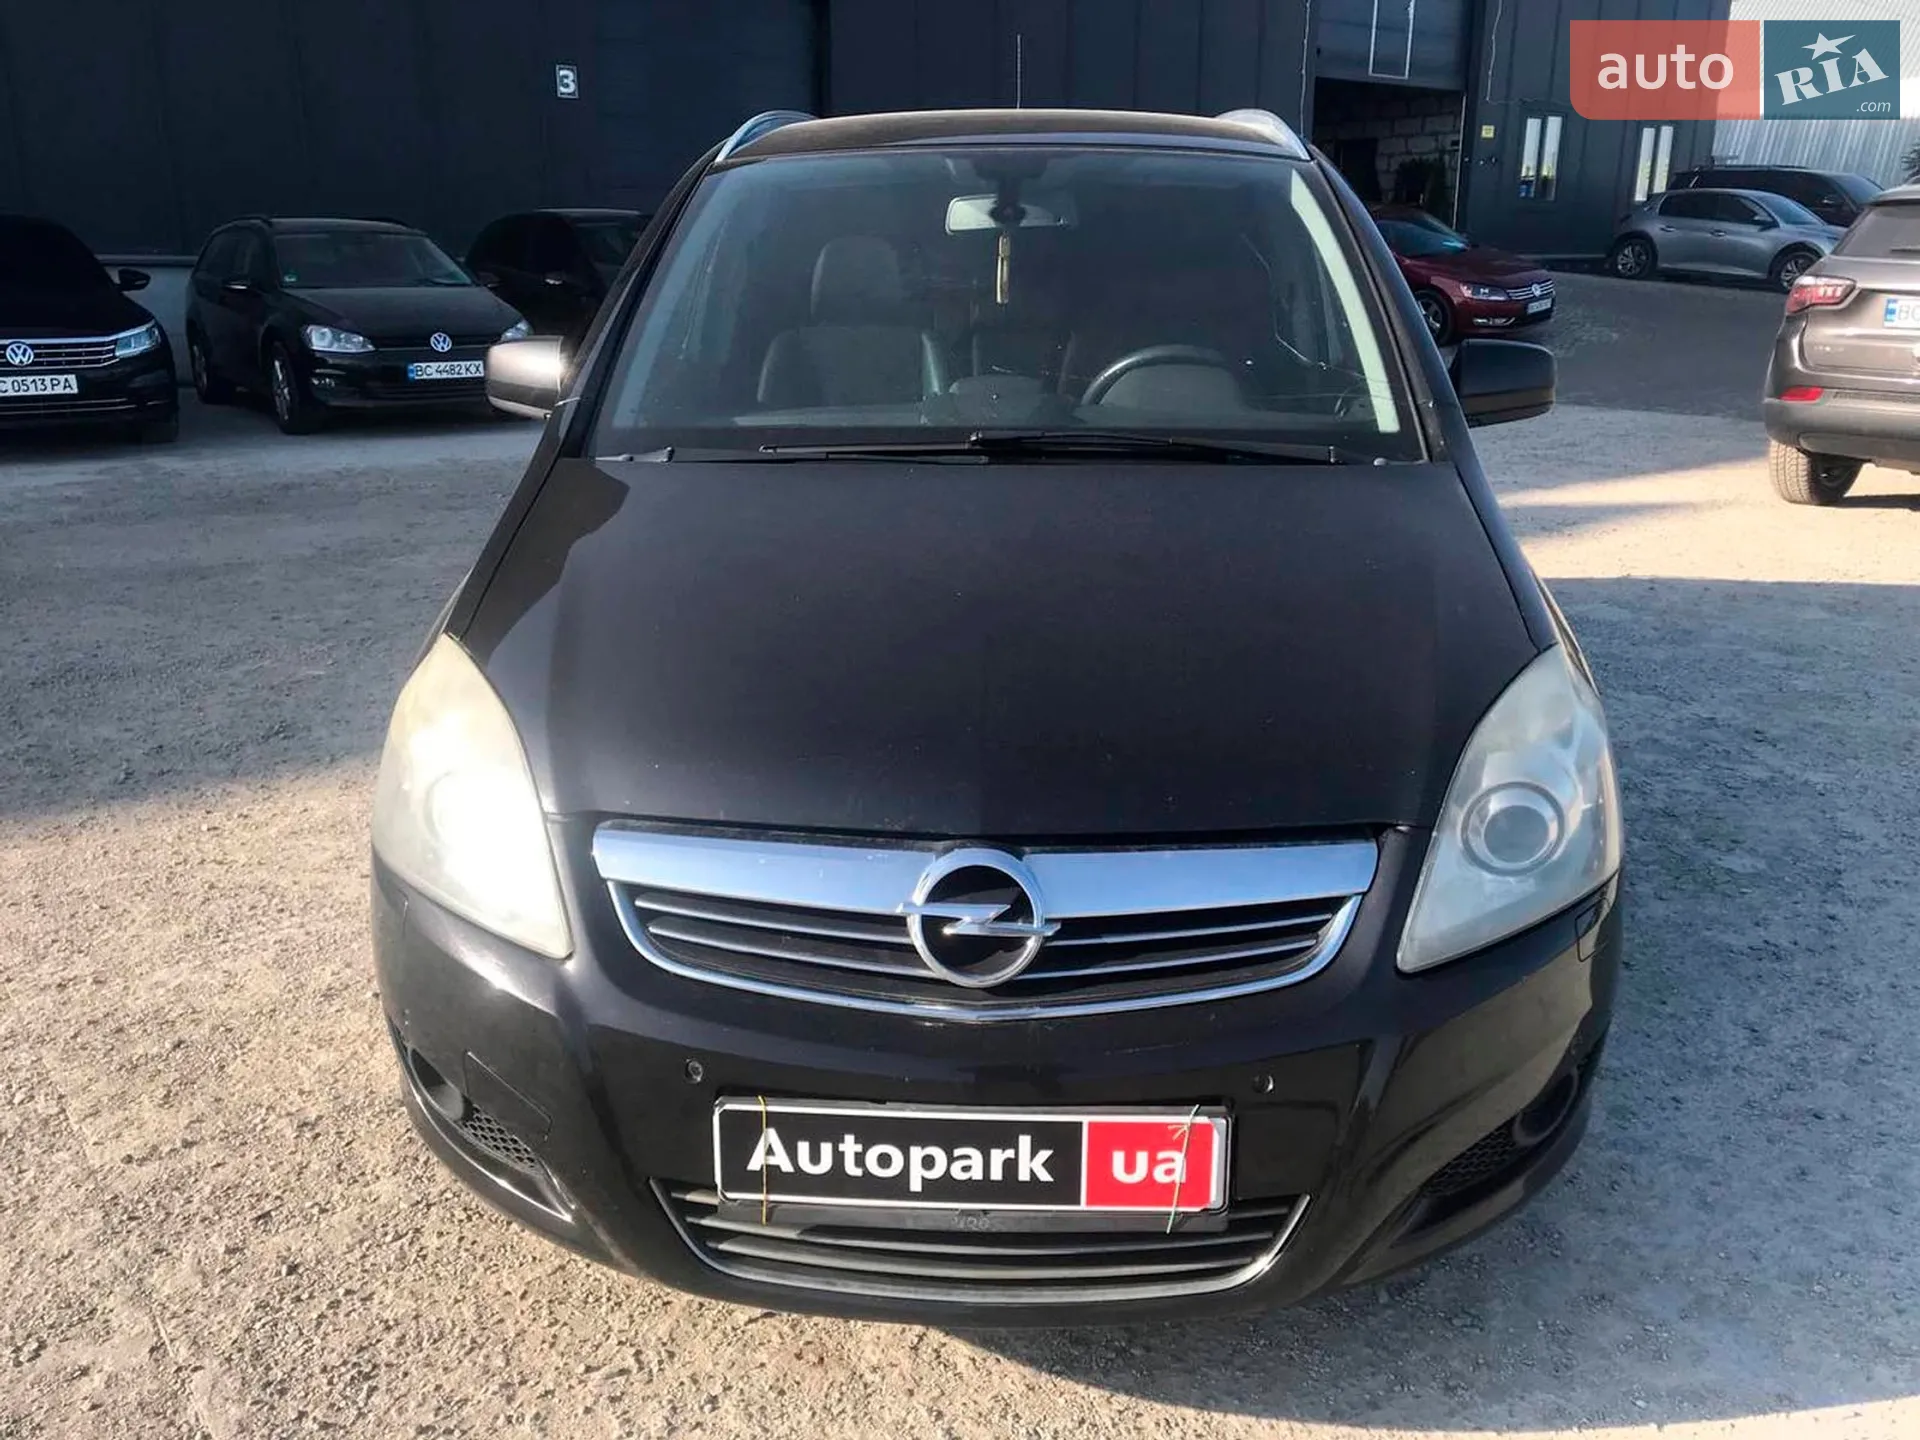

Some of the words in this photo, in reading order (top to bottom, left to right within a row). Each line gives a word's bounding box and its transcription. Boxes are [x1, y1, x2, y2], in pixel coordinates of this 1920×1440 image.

[559, 69, 576, 94] 3
[746, 1127, 1055, 1192] Autopark
[1111, 1148, 1188, 1184] ua
